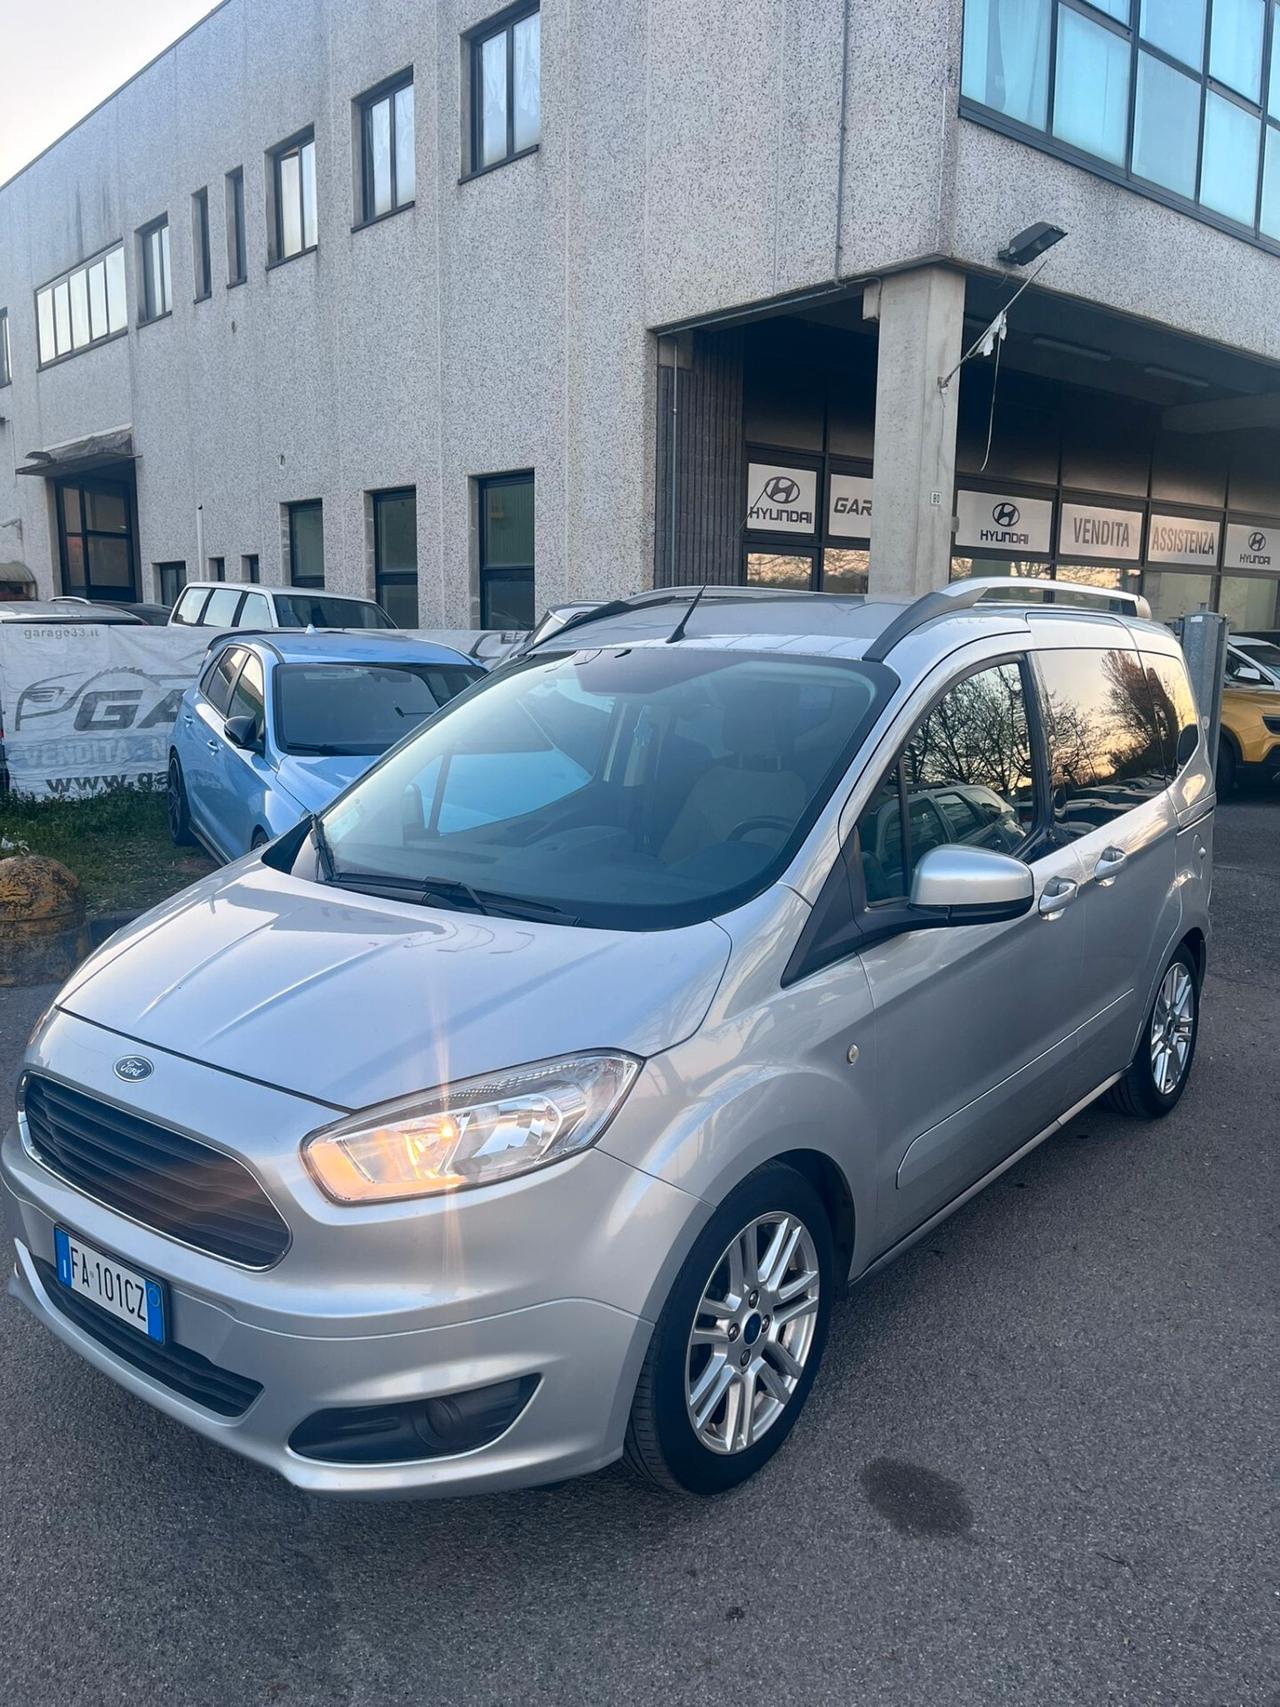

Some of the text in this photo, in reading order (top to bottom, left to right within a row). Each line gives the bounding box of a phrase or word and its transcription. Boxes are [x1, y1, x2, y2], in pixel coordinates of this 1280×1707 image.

[750, 506, 812, 525] HYUNDAI
[980, 528, 1029, 545] HYUNDAI
[1073, 516, 1130, 547] VENDITA
[1151, 525, 1215, 555] ASSISTENZA
[1239, 552, 1271, 566] HYUNDAI
[24, 628, 100, 640] garage33.it
[120, 1059, 145, 1077] Ford
